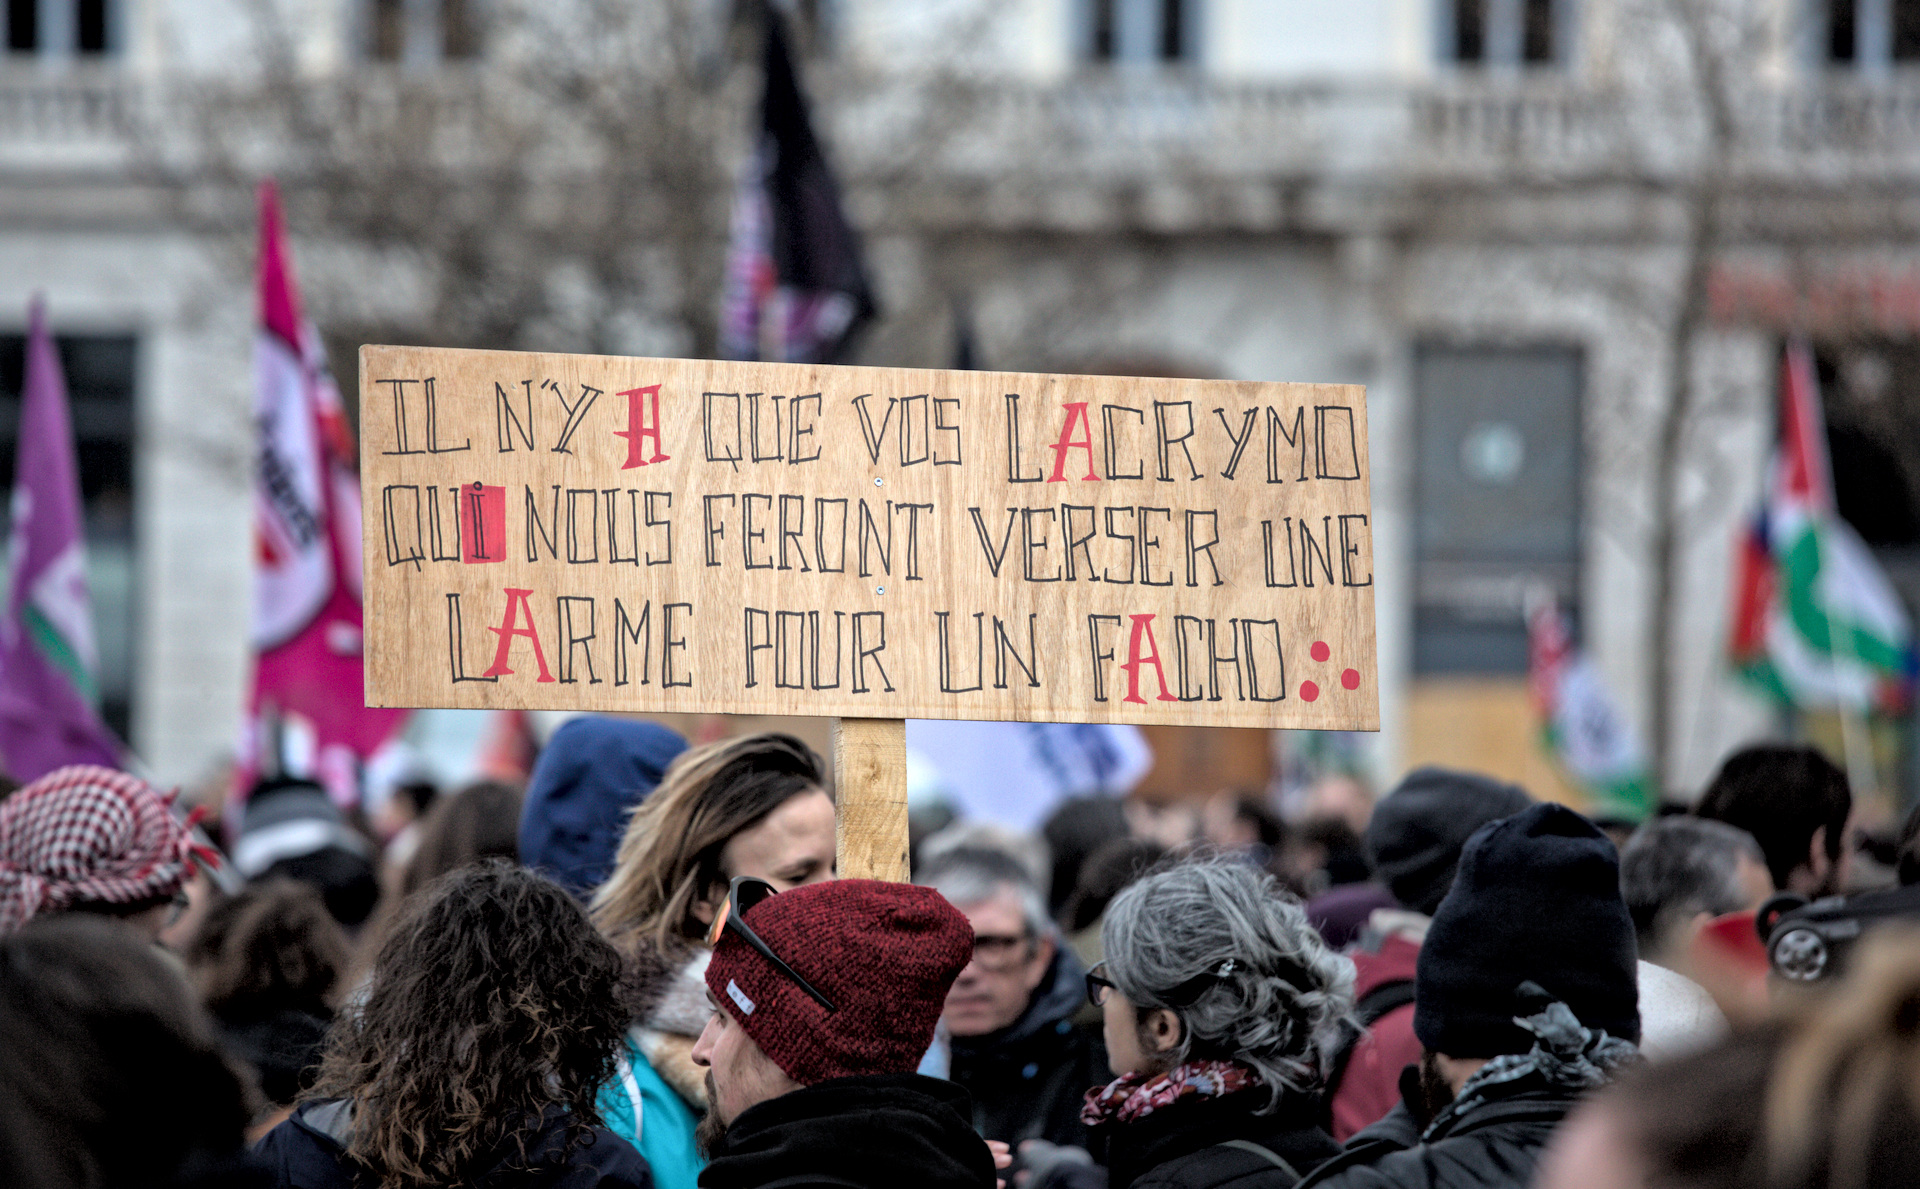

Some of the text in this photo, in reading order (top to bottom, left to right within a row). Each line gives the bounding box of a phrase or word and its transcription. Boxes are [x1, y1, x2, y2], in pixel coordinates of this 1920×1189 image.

[376, 377, 1361, 484] IL N'Y A QUE VOS LACRYMO
[525, 484, 672, 567] NOUS
[703, 493, 934, 580] FERONT
[967, 502, 1224, 587] VERSER
[1261, 514, 1373, 588] UNE
[446, 587, 1287, 704] LARME POUR UN FACHO
